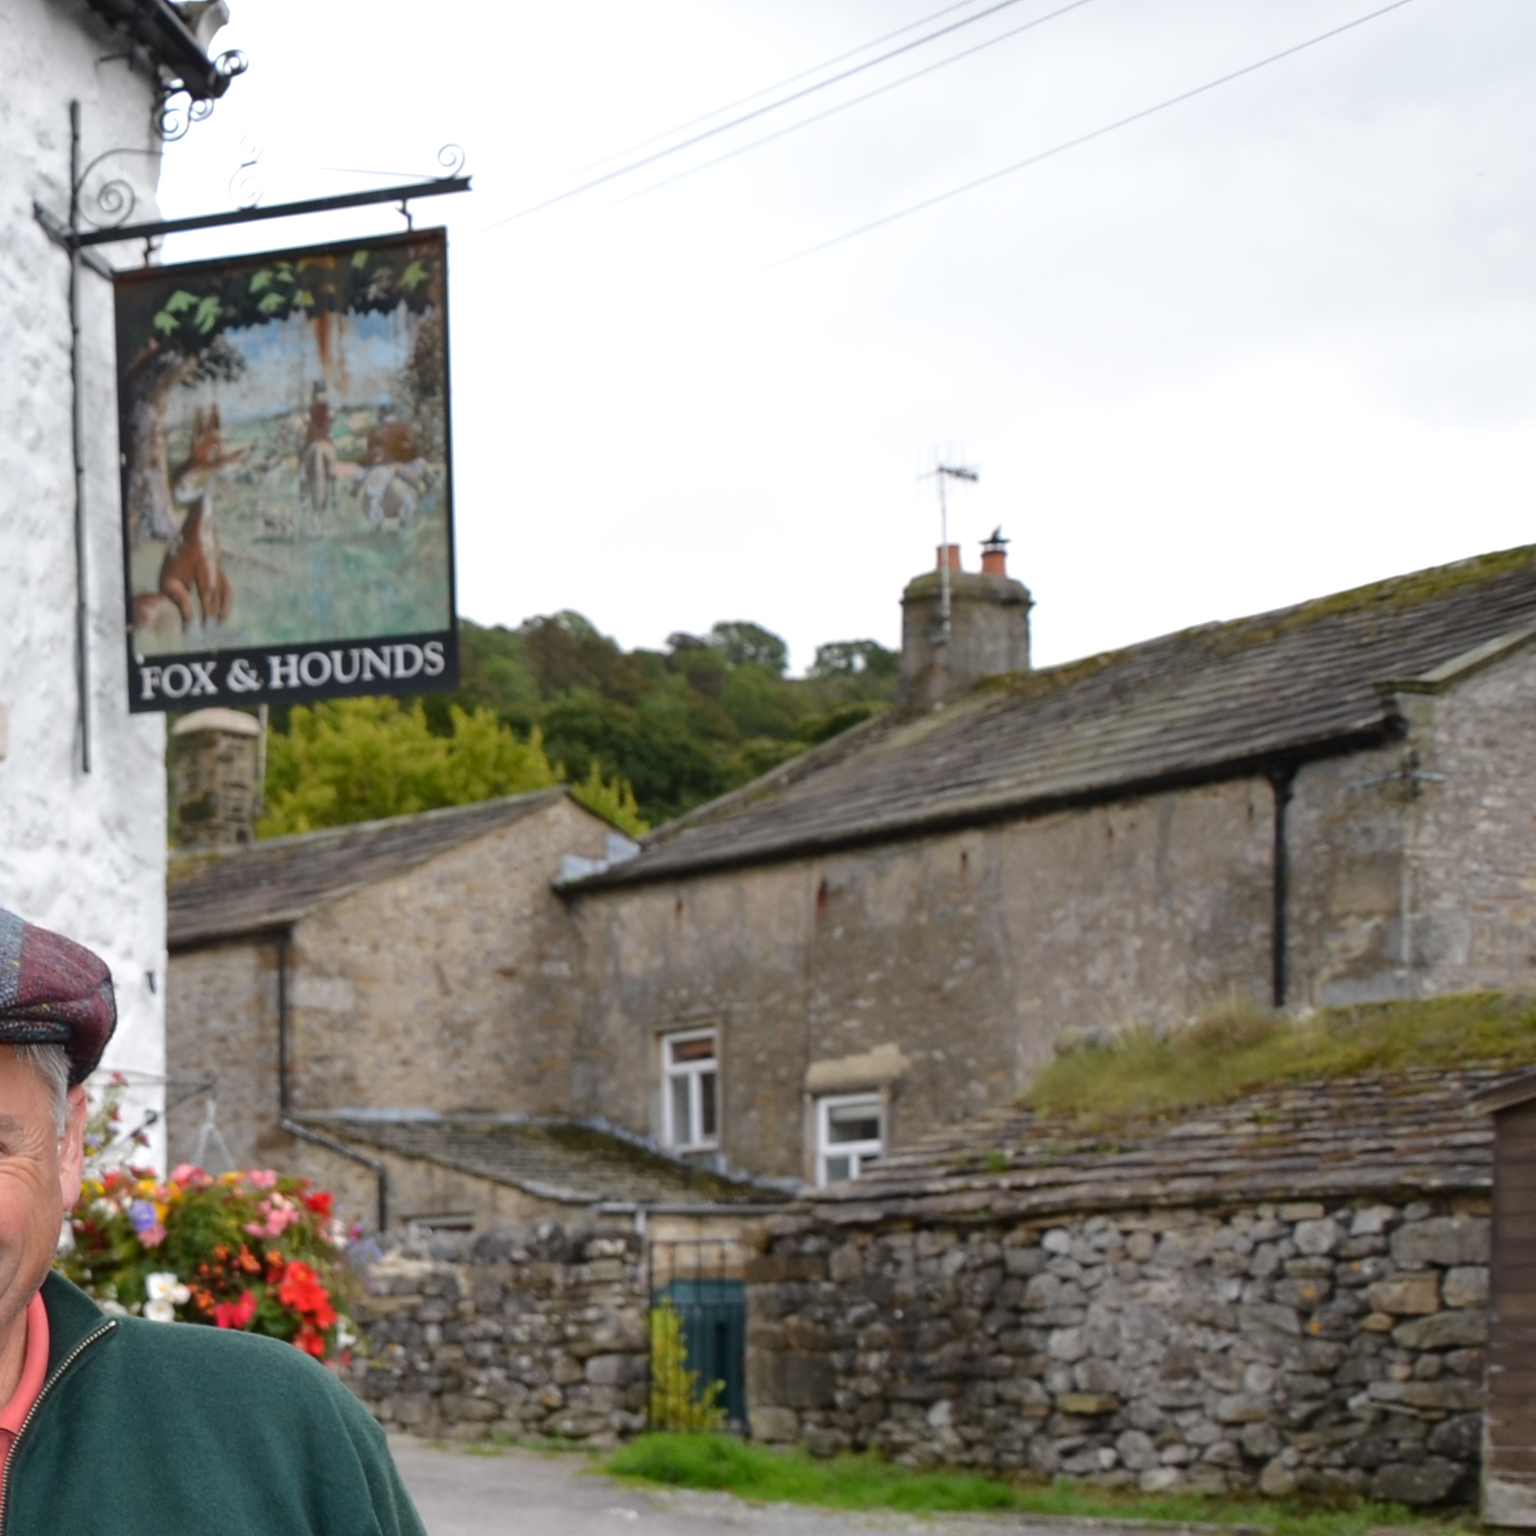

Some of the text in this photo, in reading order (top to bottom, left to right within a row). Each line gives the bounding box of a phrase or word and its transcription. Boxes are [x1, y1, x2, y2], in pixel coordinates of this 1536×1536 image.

[140, 641, 446, 700] FOX & HOUNDS
